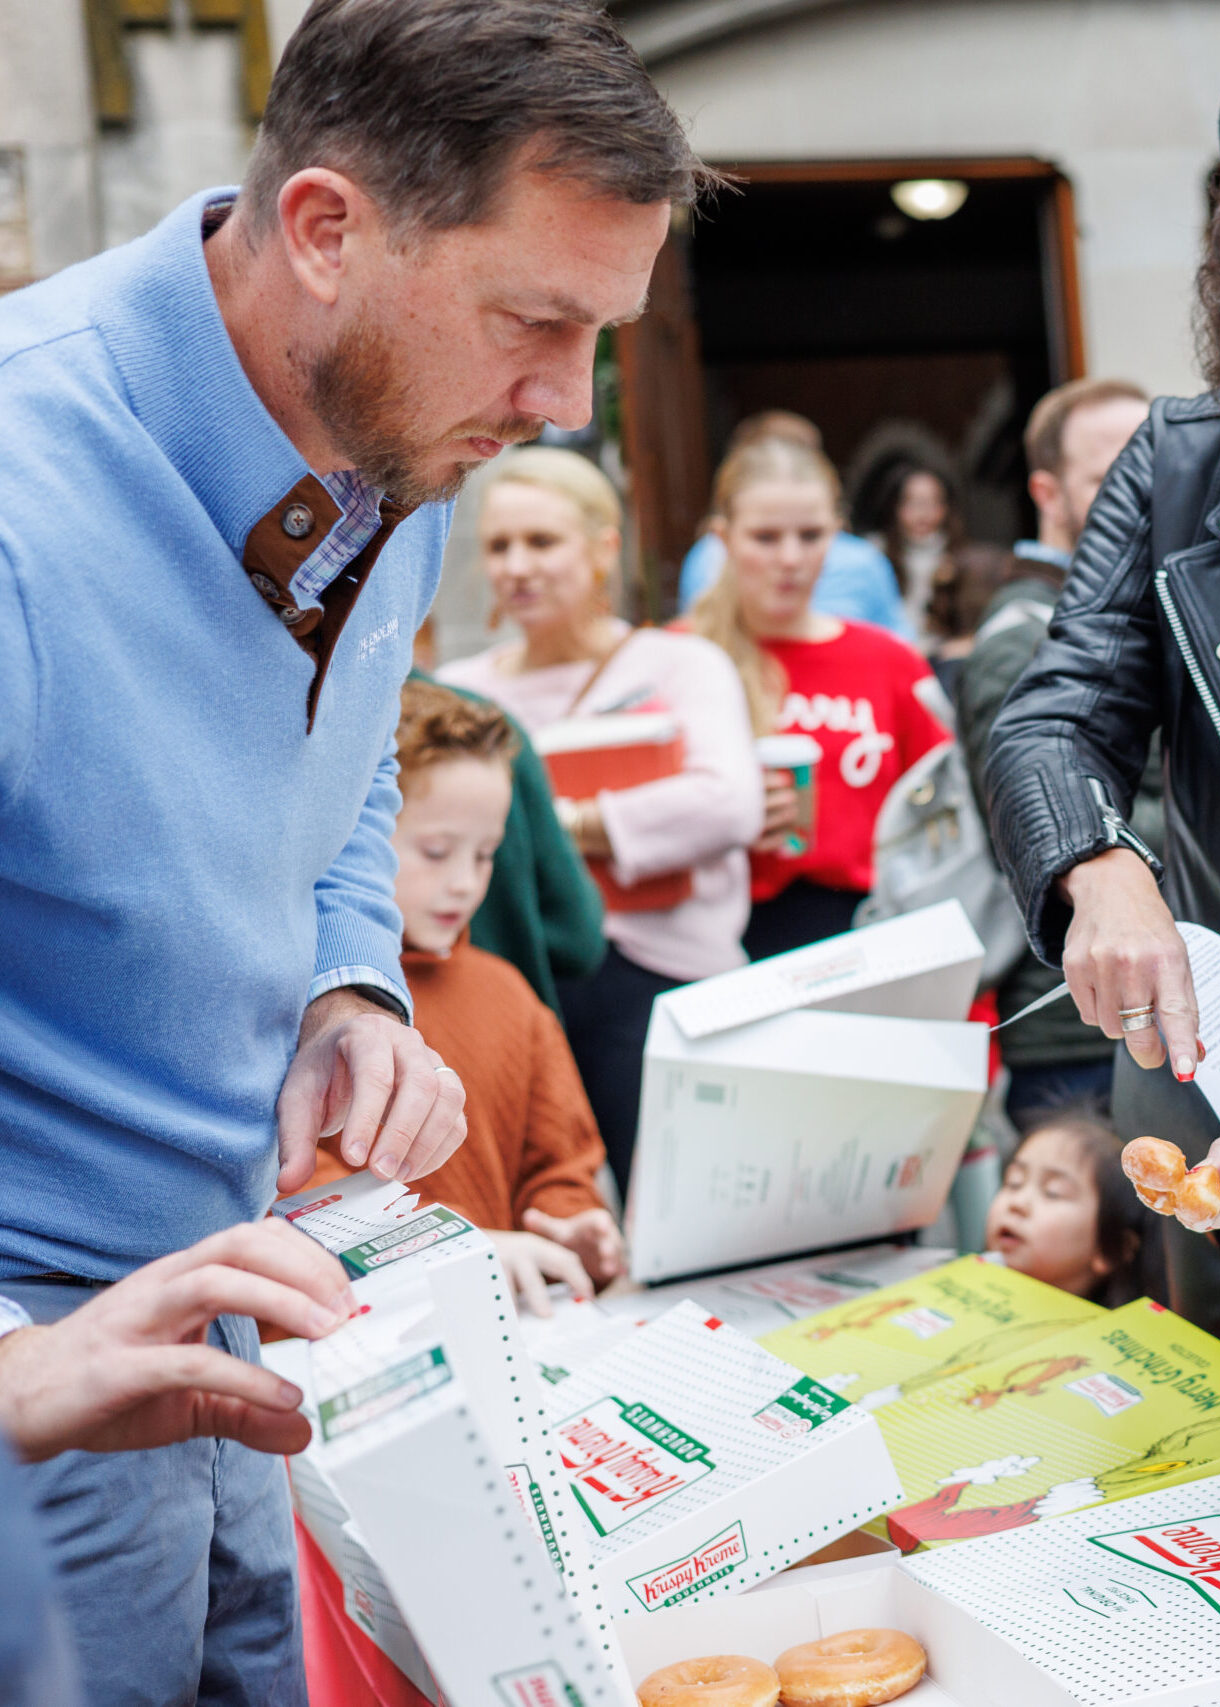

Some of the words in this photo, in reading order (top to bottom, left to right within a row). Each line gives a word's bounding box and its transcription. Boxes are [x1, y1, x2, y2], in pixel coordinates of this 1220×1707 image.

[1101, 1329, 1183, 1384] Grinchmas
[558, 1417, 635, 1478] Kreme
[625, 1405, 704, 1460] DOUGHNUTS
[582, 1448, 686, 1511] Krispy
[531, 1487, 563, 1569] DOUGHNUTS
[643, 1560, 694, 1603] Krispy
[693, 1534, 740, 1576] Kreme
[668, 1566, 731, 1605] DOUGHNUTS
